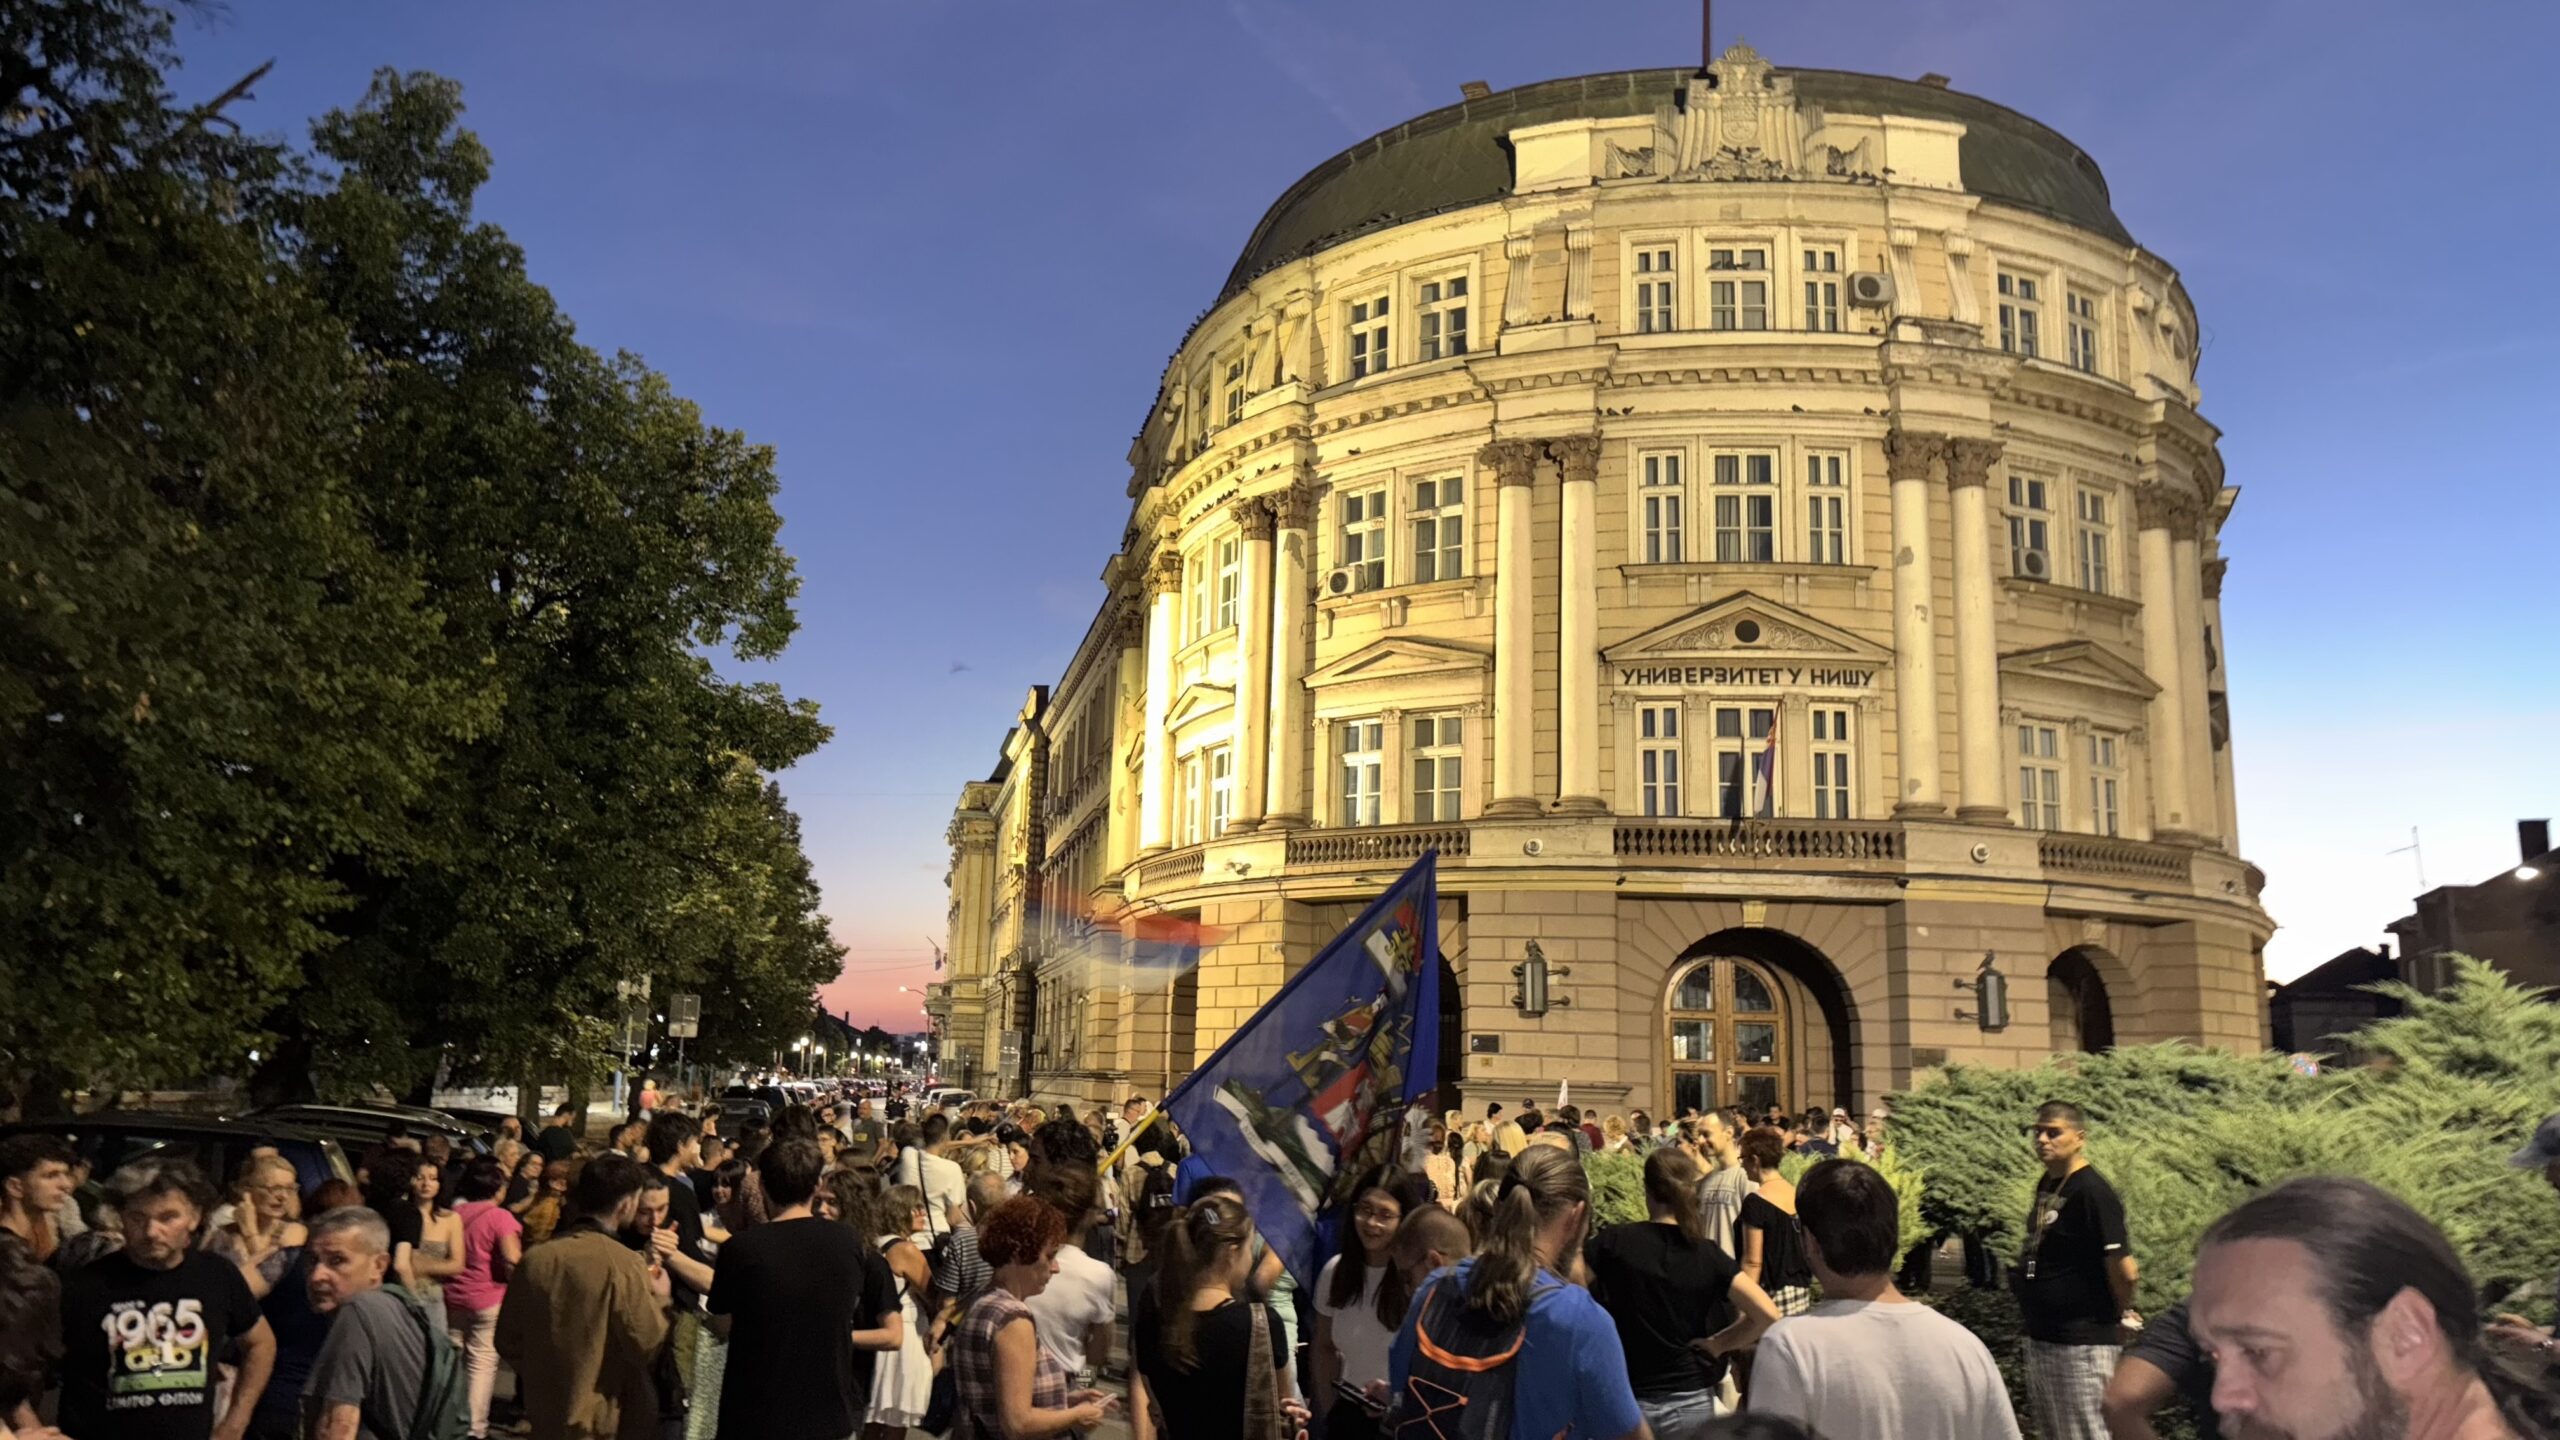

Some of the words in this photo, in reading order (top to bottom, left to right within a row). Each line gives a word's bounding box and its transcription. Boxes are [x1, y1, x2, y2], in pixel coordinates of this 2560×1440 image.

[1620, 667, 1783, 685] УНИВЕРЗИТЕТ
[1787, 668, 1803, 684] У
[1810, 668, 1875, 686] НИШУ
[101, 1298, 205, 1350] 1965
